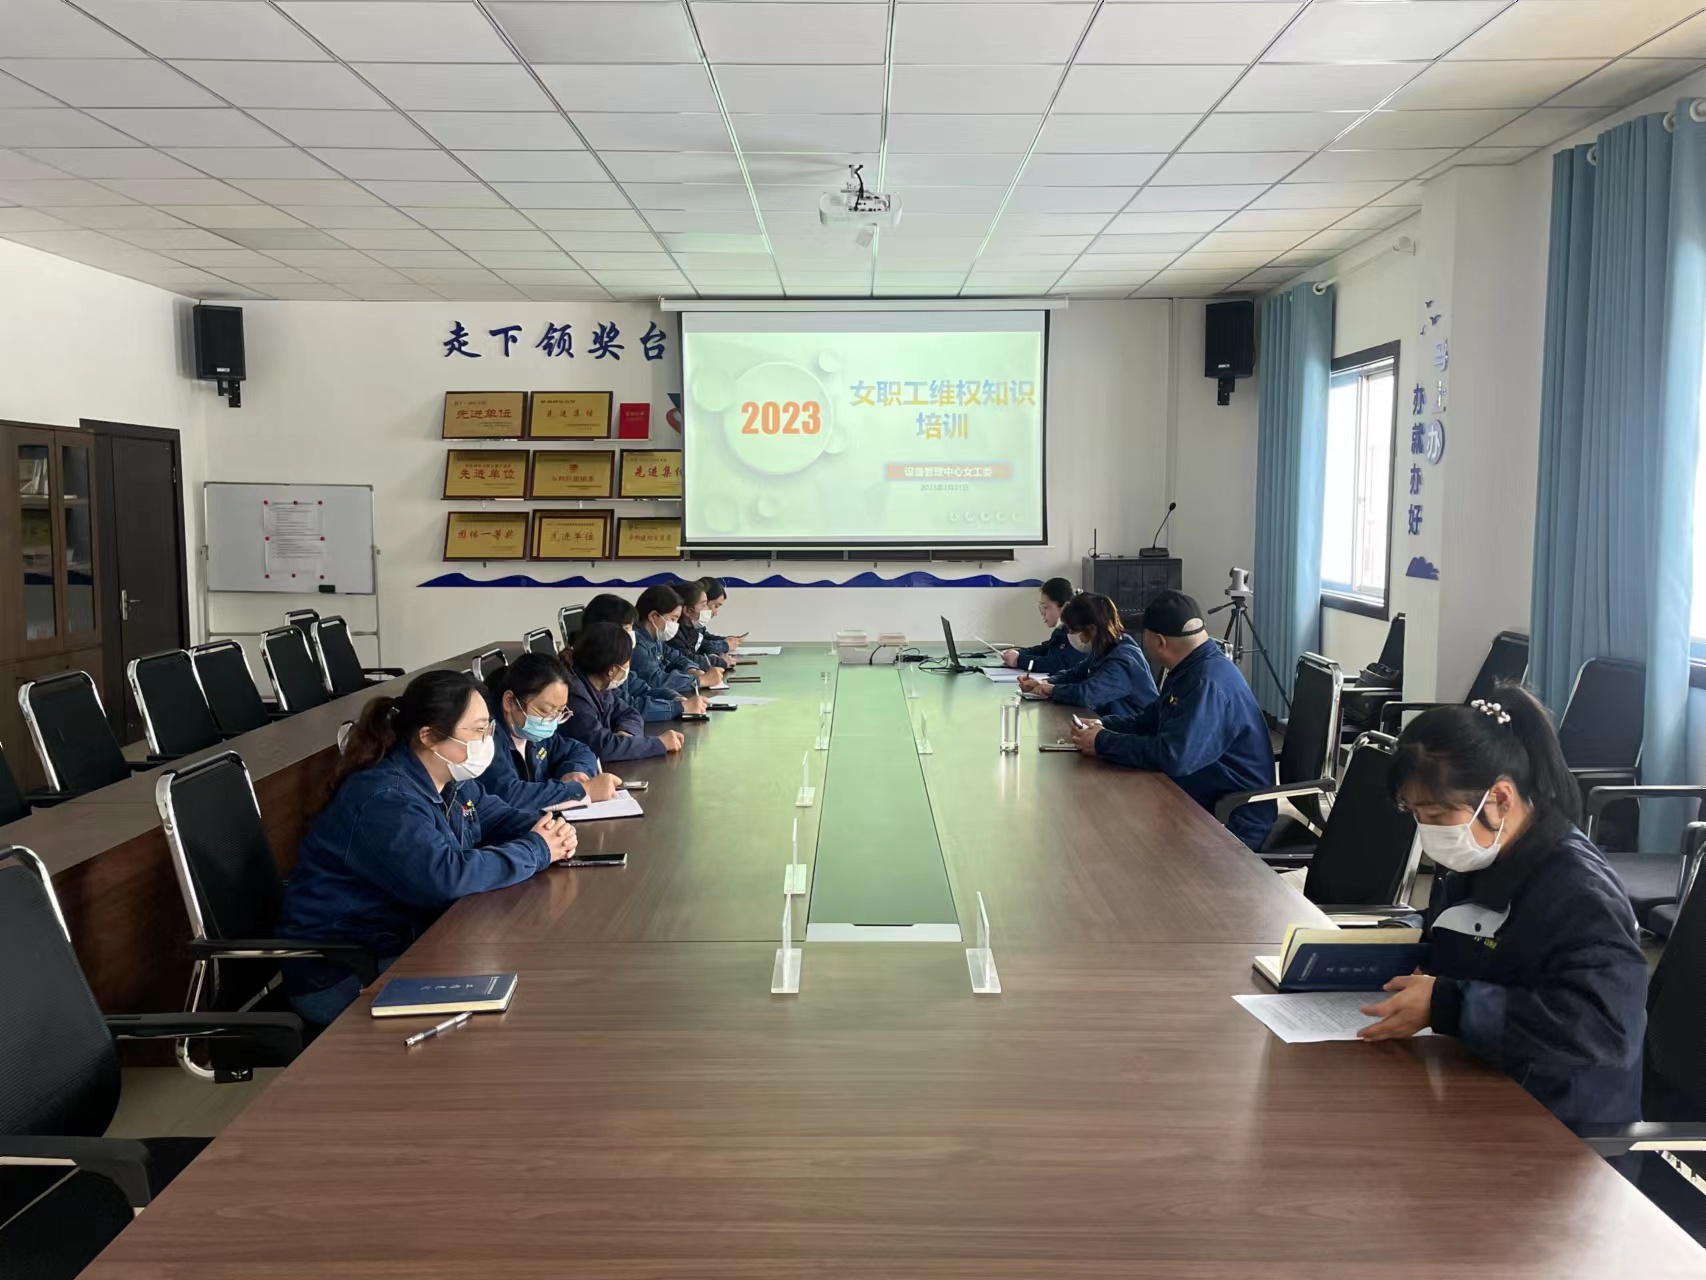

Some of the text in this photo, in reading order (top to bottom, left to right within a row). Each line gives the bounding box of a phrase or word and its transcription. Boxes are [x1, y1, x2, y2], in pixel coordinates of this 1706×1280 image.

[443, 320, 667, 361] 走下领奖台
[850, 379, 1036, 407] 女职工维权知识
[740, 401, 822, 435] 2023
[916, 411, 969, 440] 培训
[458, 468, 516, 480] 先进单位
[1408, 383, 1426, 536] 办就办好
